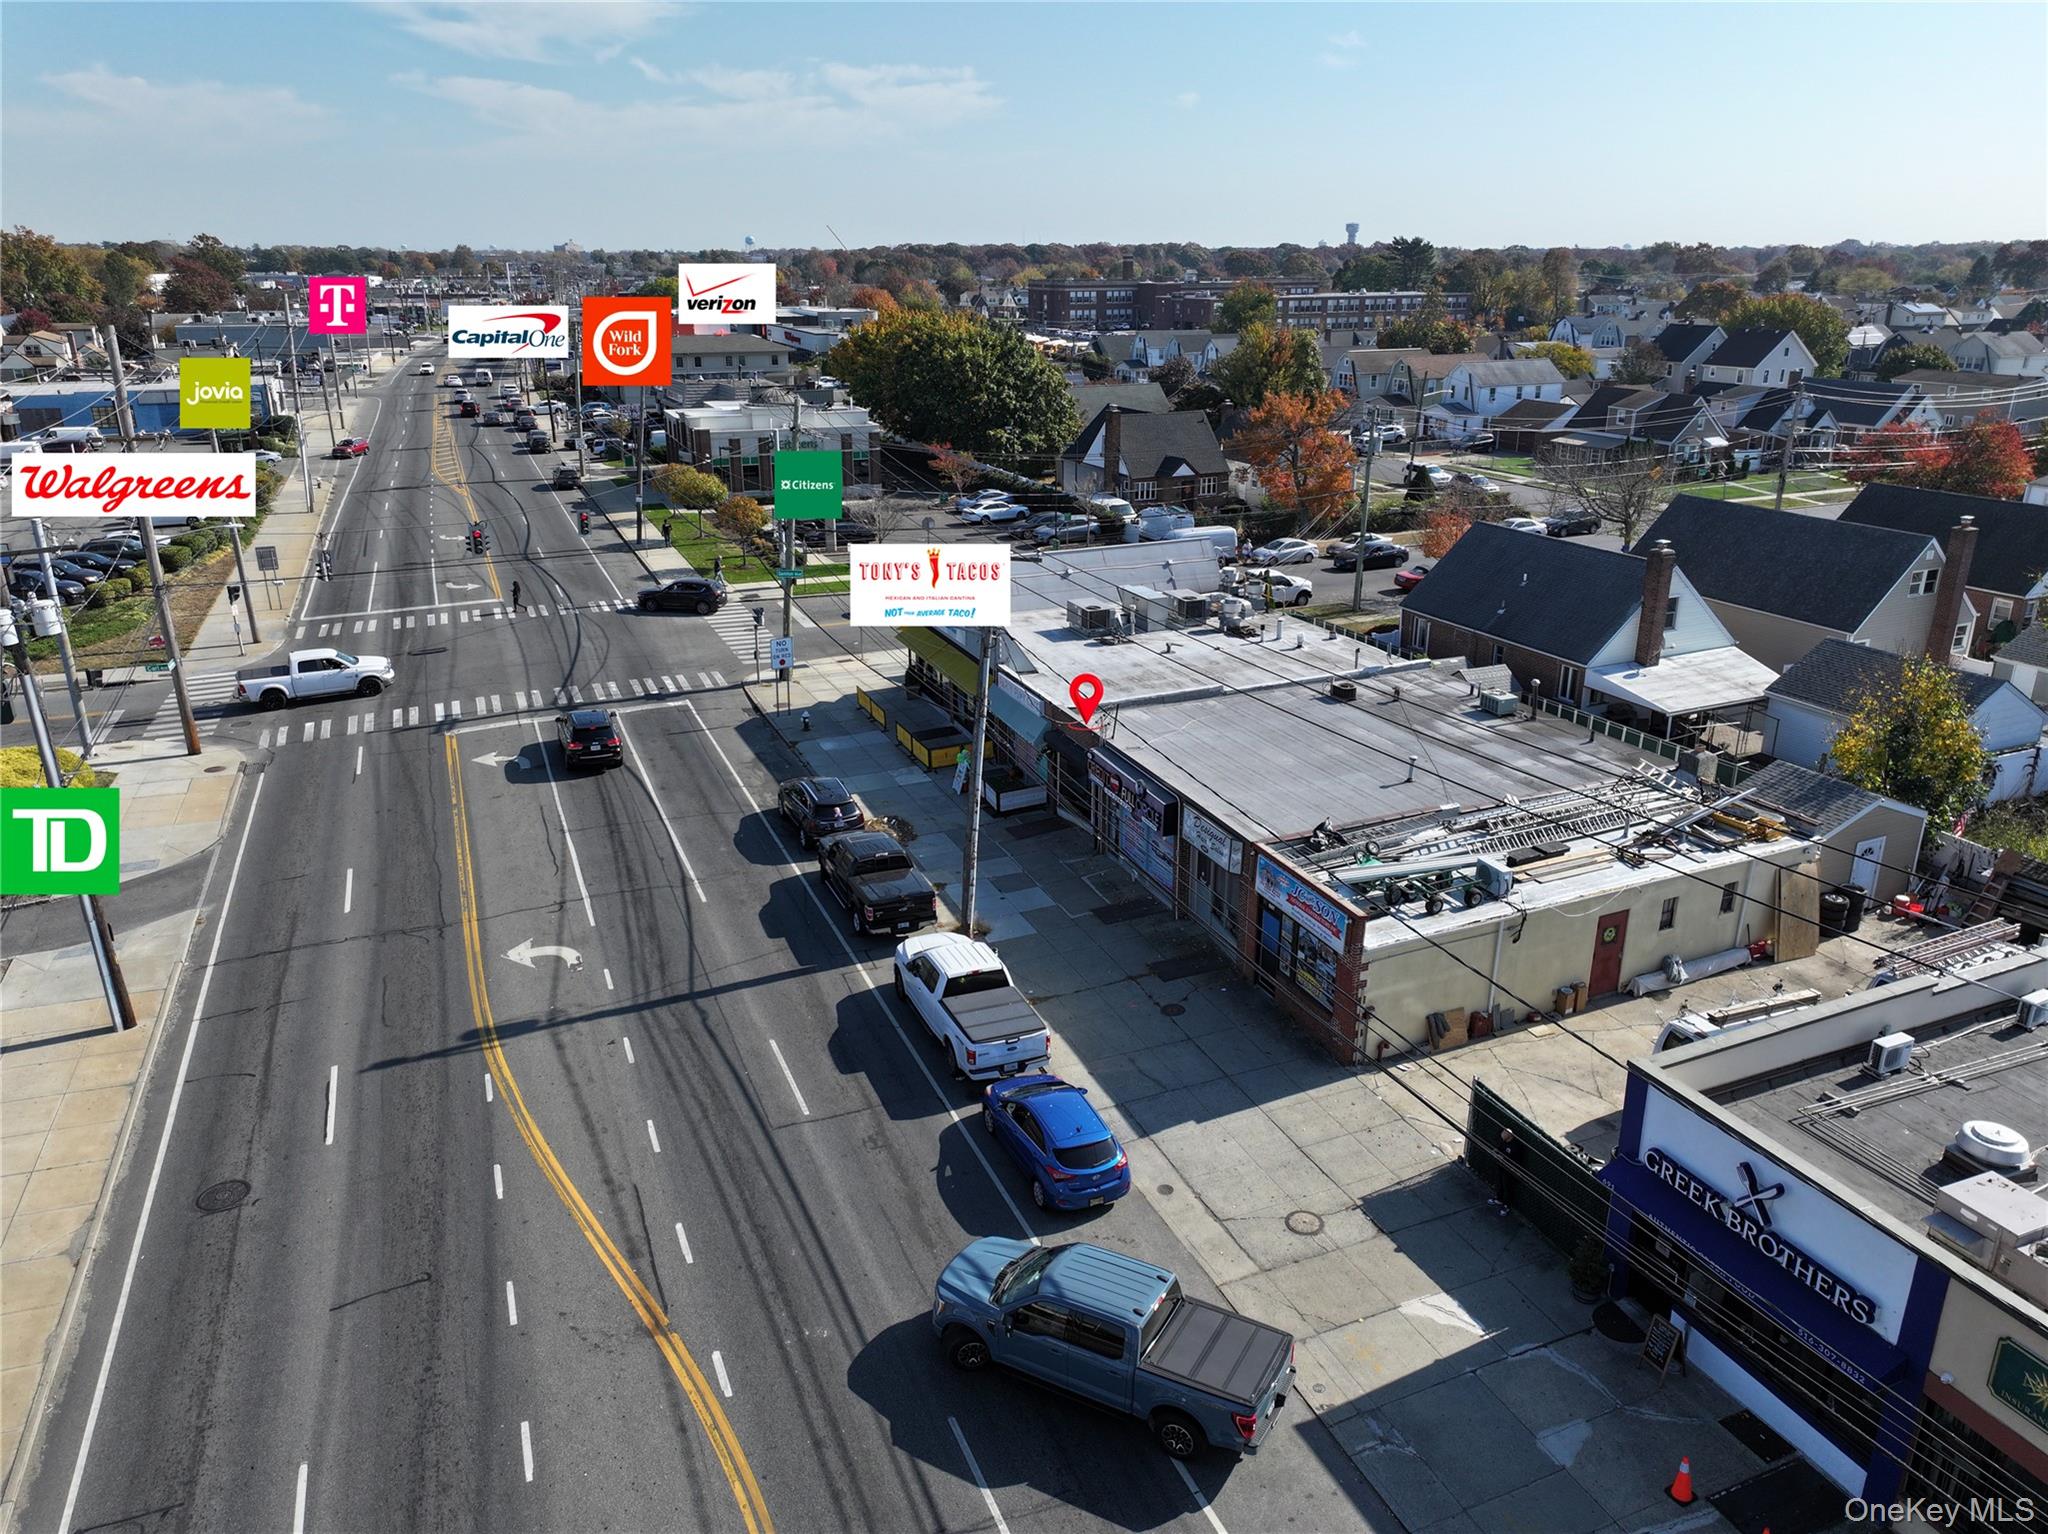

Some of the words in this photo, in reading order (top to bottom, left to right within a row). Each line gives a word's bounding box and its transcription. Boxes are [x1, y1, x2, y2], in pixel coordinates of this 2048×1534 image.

[1291, 885, 1306, 901] JC
[1313, 899, 1338, 925] SON
[1643, 1151, 1720, 1219] GREEK
[1726, 1206, 1870, 1324] BROTHERS
[2001, 1389, 2048, 1429] INSURAN
